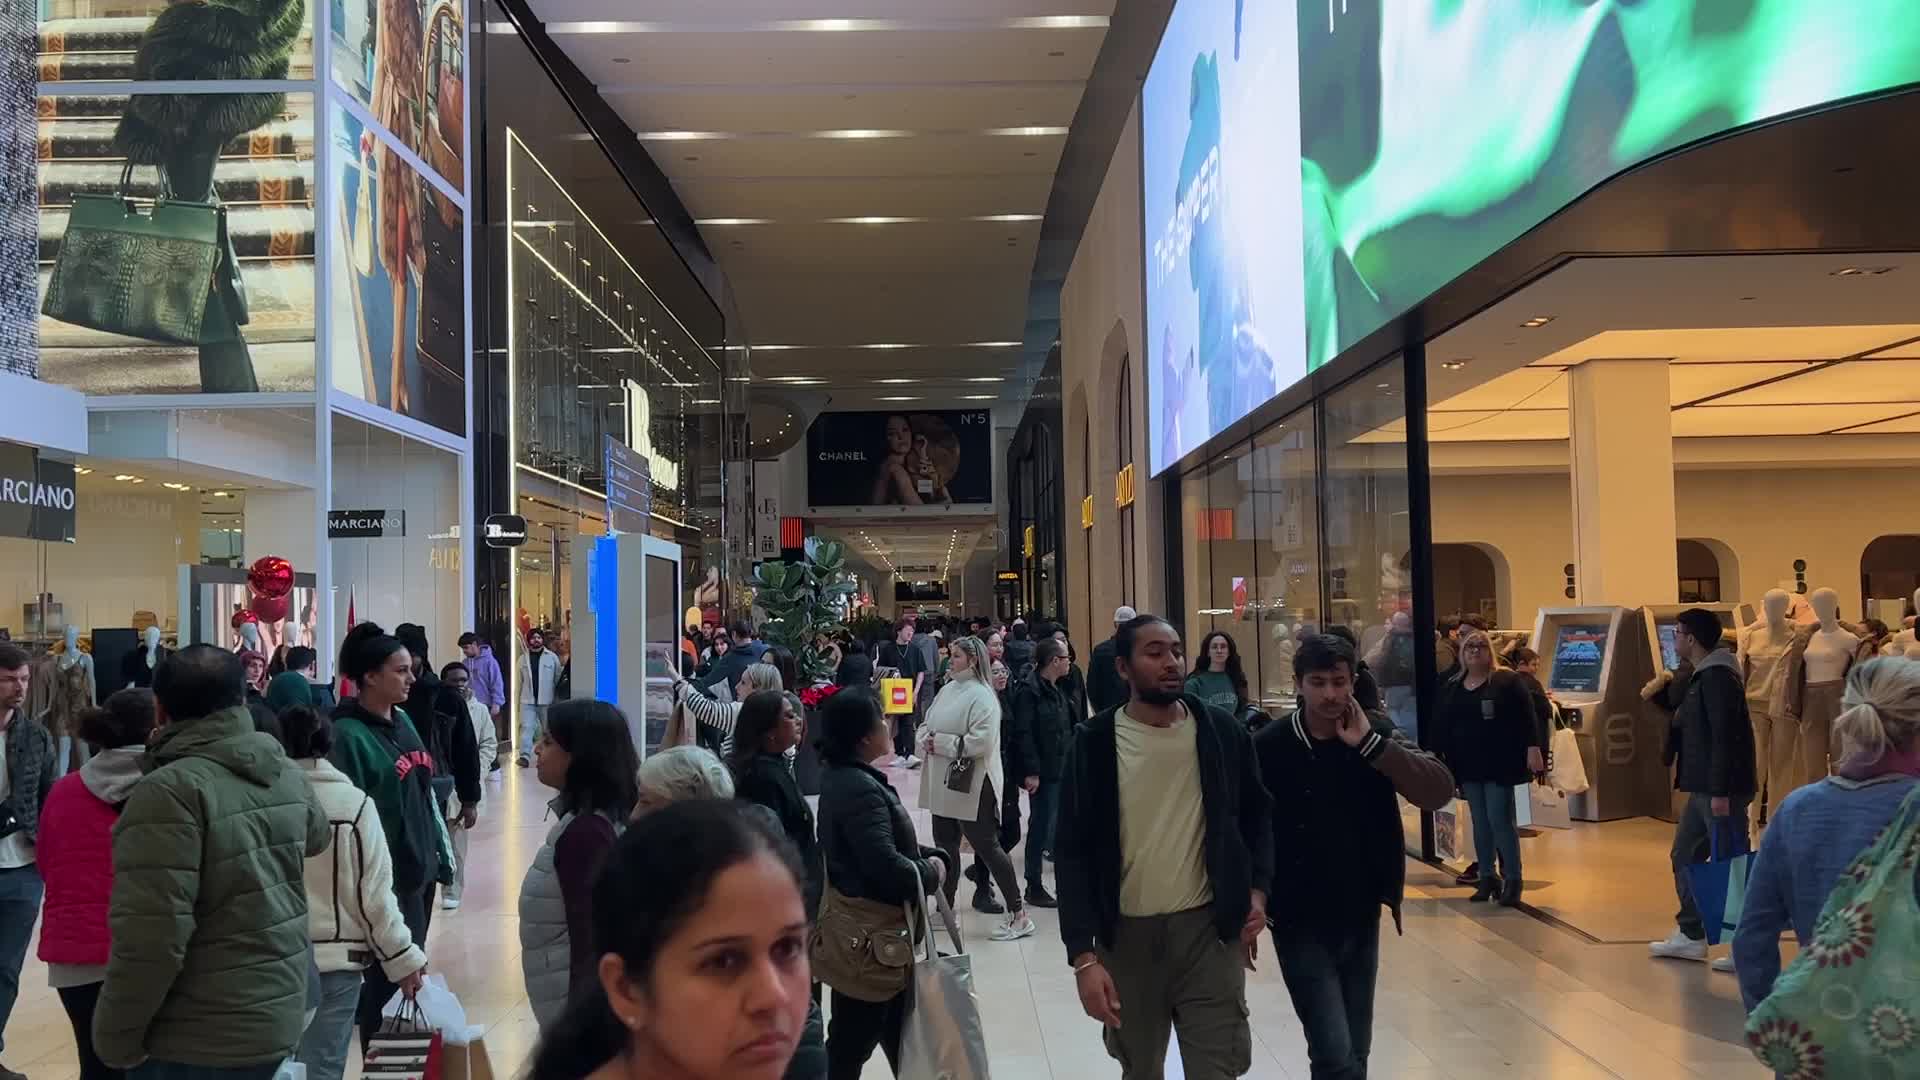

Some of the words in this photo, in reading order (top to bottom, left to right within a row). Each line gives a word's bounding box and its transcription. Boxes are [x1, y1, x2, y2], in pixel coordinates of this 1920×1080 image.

[818, 452, 868, 461] CHANEL
[0, 478, 75, 510] RCIANO
[329, 518, 401, 529] MARCIANO
